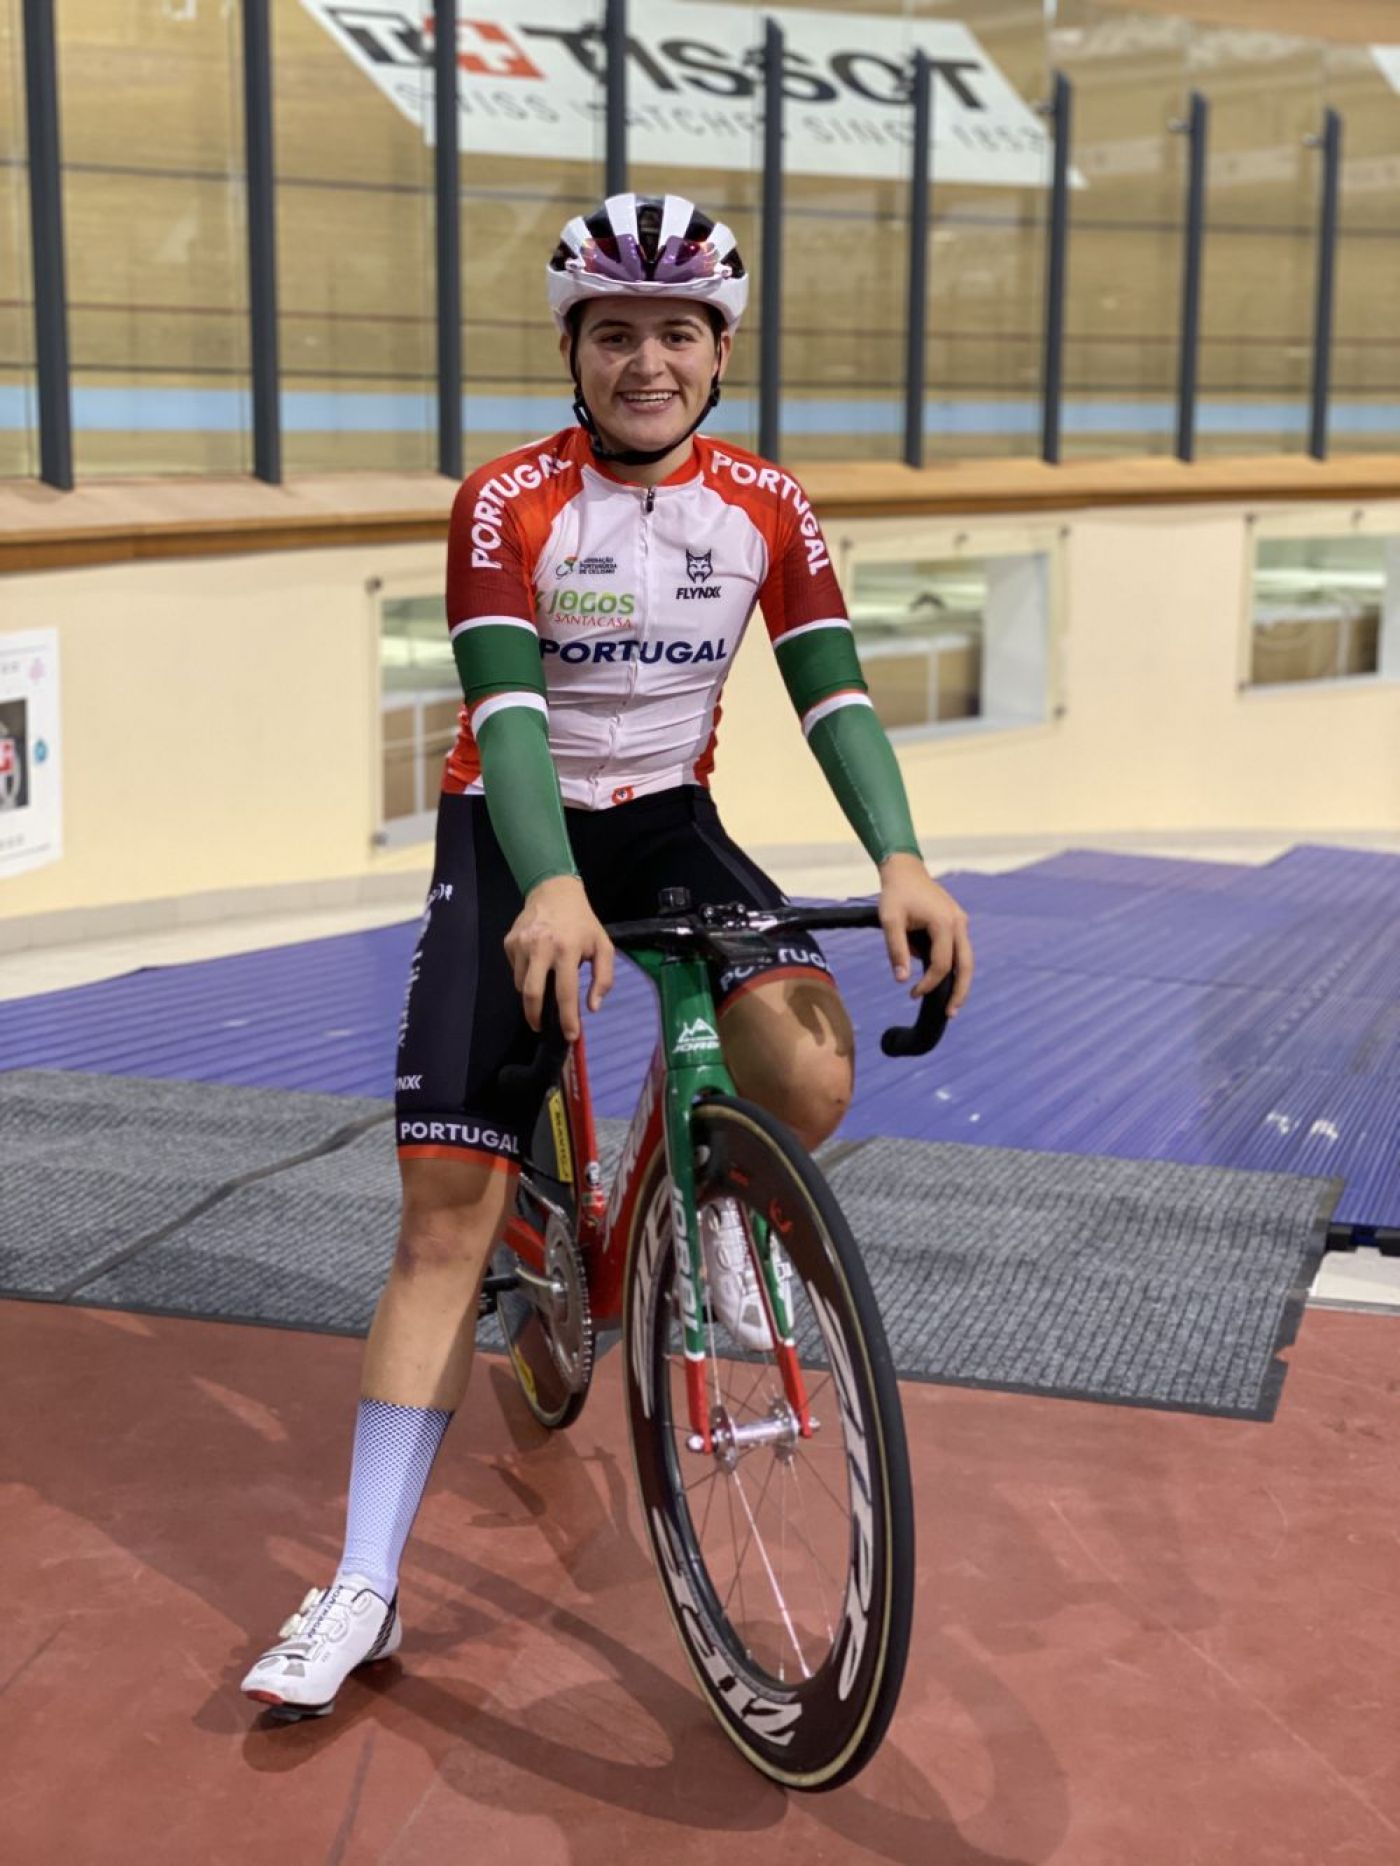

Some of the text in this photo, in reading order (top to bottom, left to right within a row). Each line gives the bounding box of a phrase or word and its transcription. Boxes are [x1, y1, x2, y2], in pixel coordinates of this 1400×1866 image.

[518, 23, 987, 110] TISSOT
[472, 453, 574, 569] PORTUGAL
[711, 450, 830, 576] PORTUGAL
[549, 588, 635, 615] JOGOS
[539, 637, 728, 664] PORTUGAL
[401, 1121, 519, 1154] PORTUGAL
[652, 1506, 803, 1746] ZIPP
